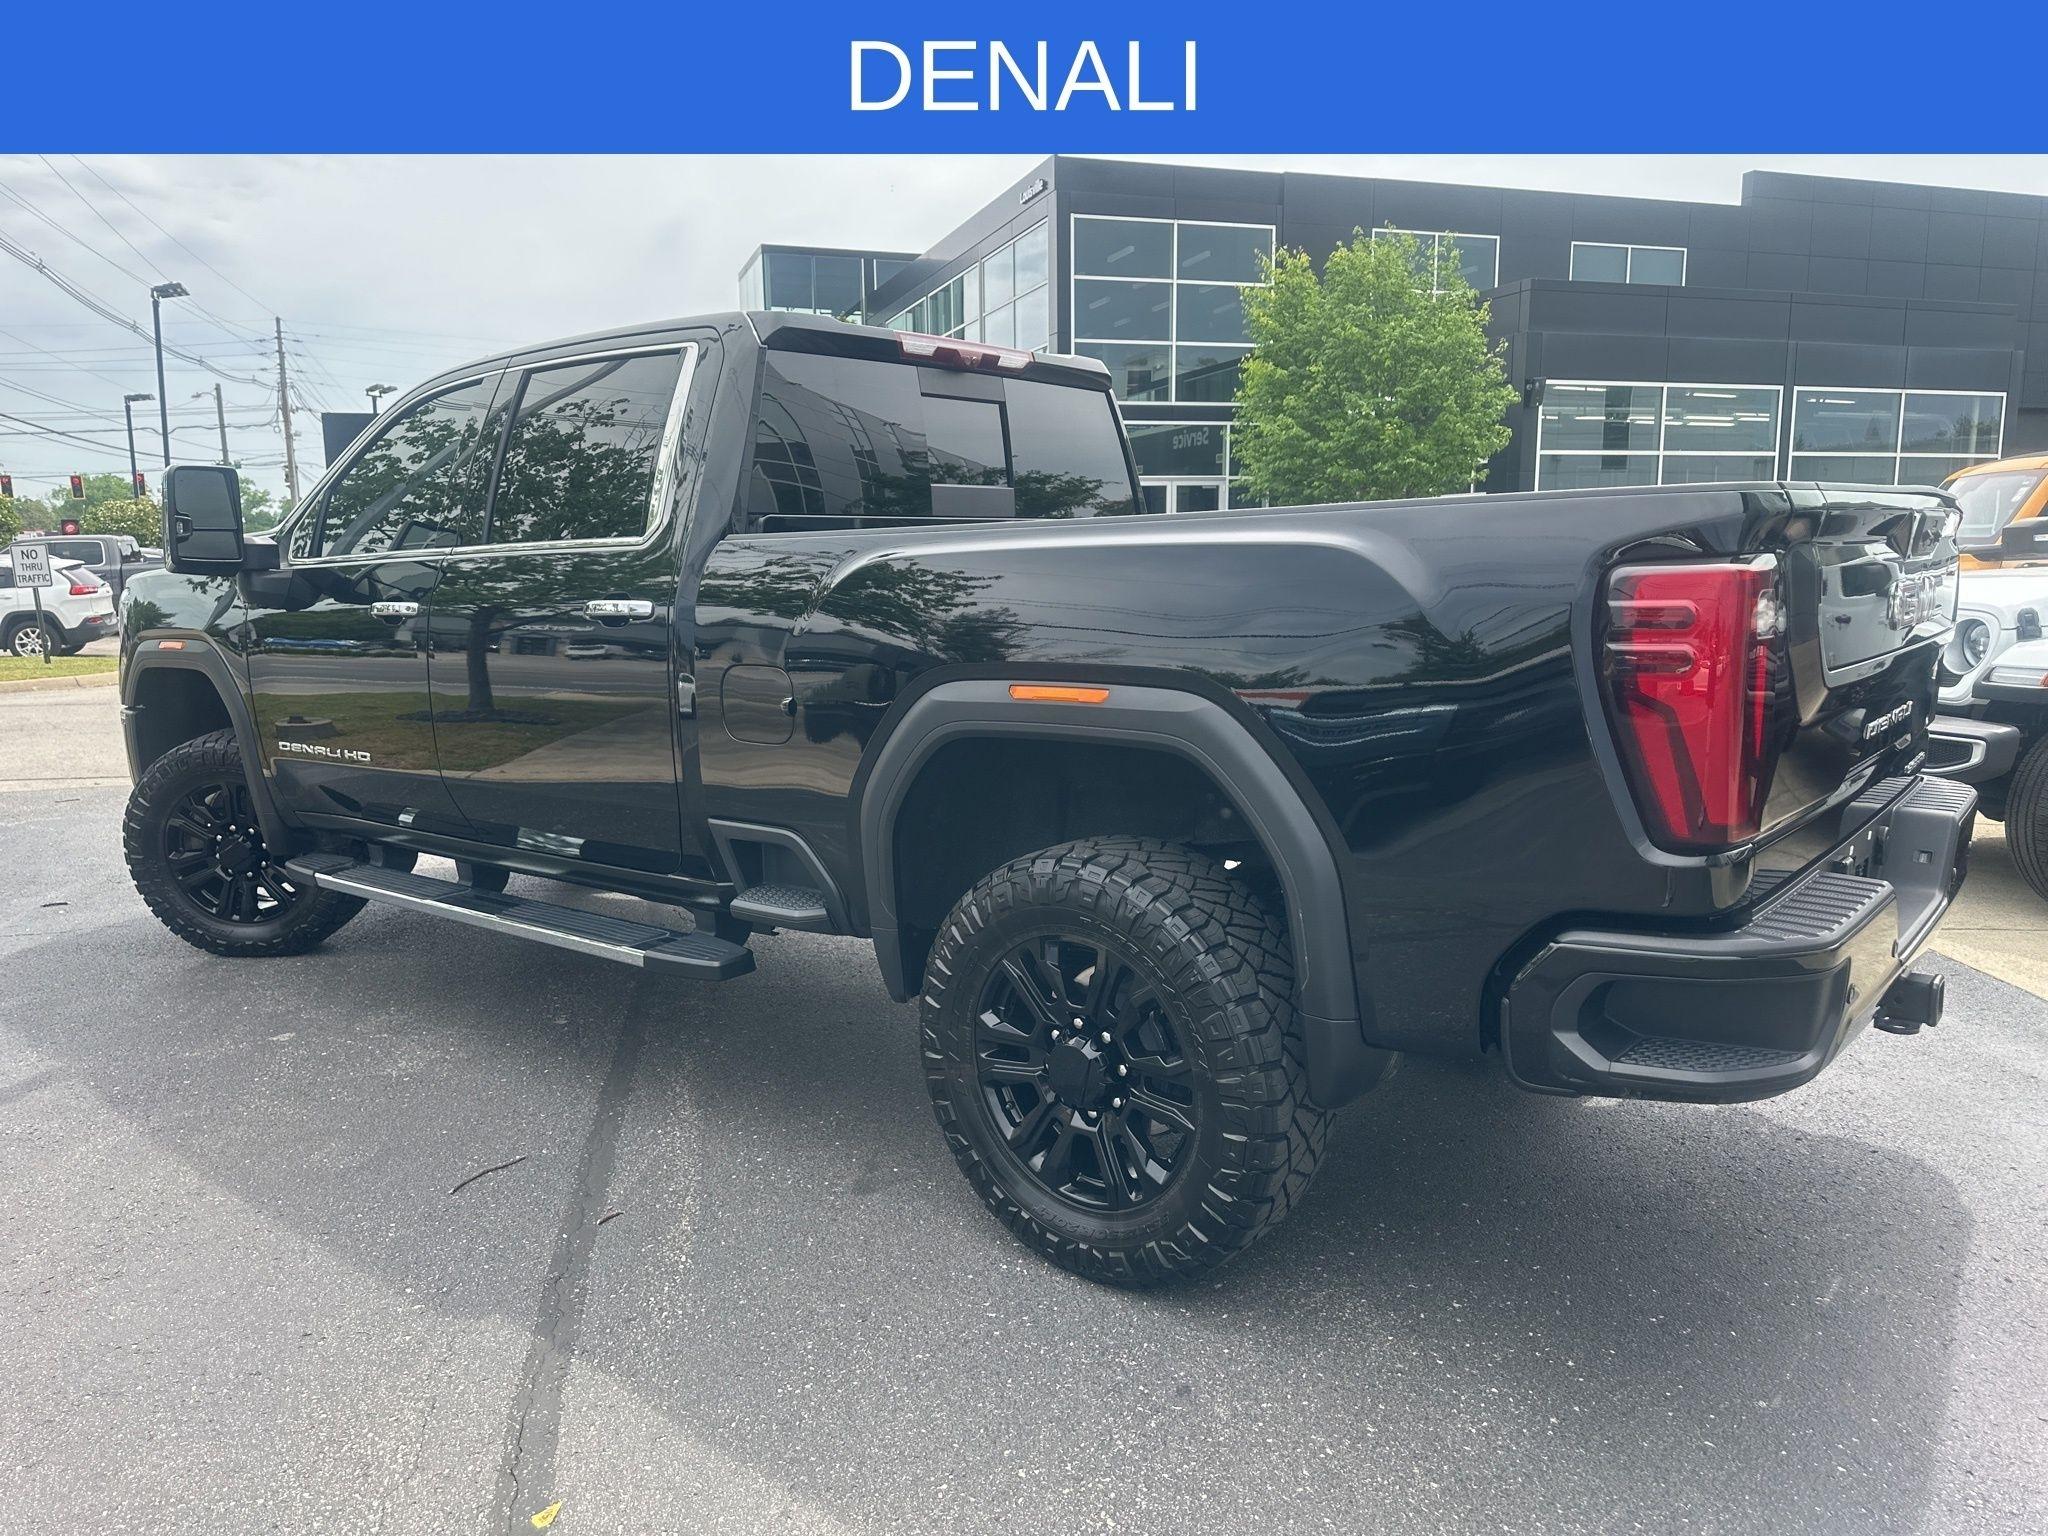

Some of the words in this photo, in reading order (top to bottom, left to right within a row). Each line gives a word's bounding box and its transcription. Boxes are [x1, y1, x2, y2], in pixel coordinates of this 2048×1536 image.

[20, 549, 38, 560] NO
[20, 563, 43, 571] THRU
[17, 573, 50, 583] TRAFFIC
[278, 741, 342, 758] DENALI
[344, 750, 371, 762] HD
